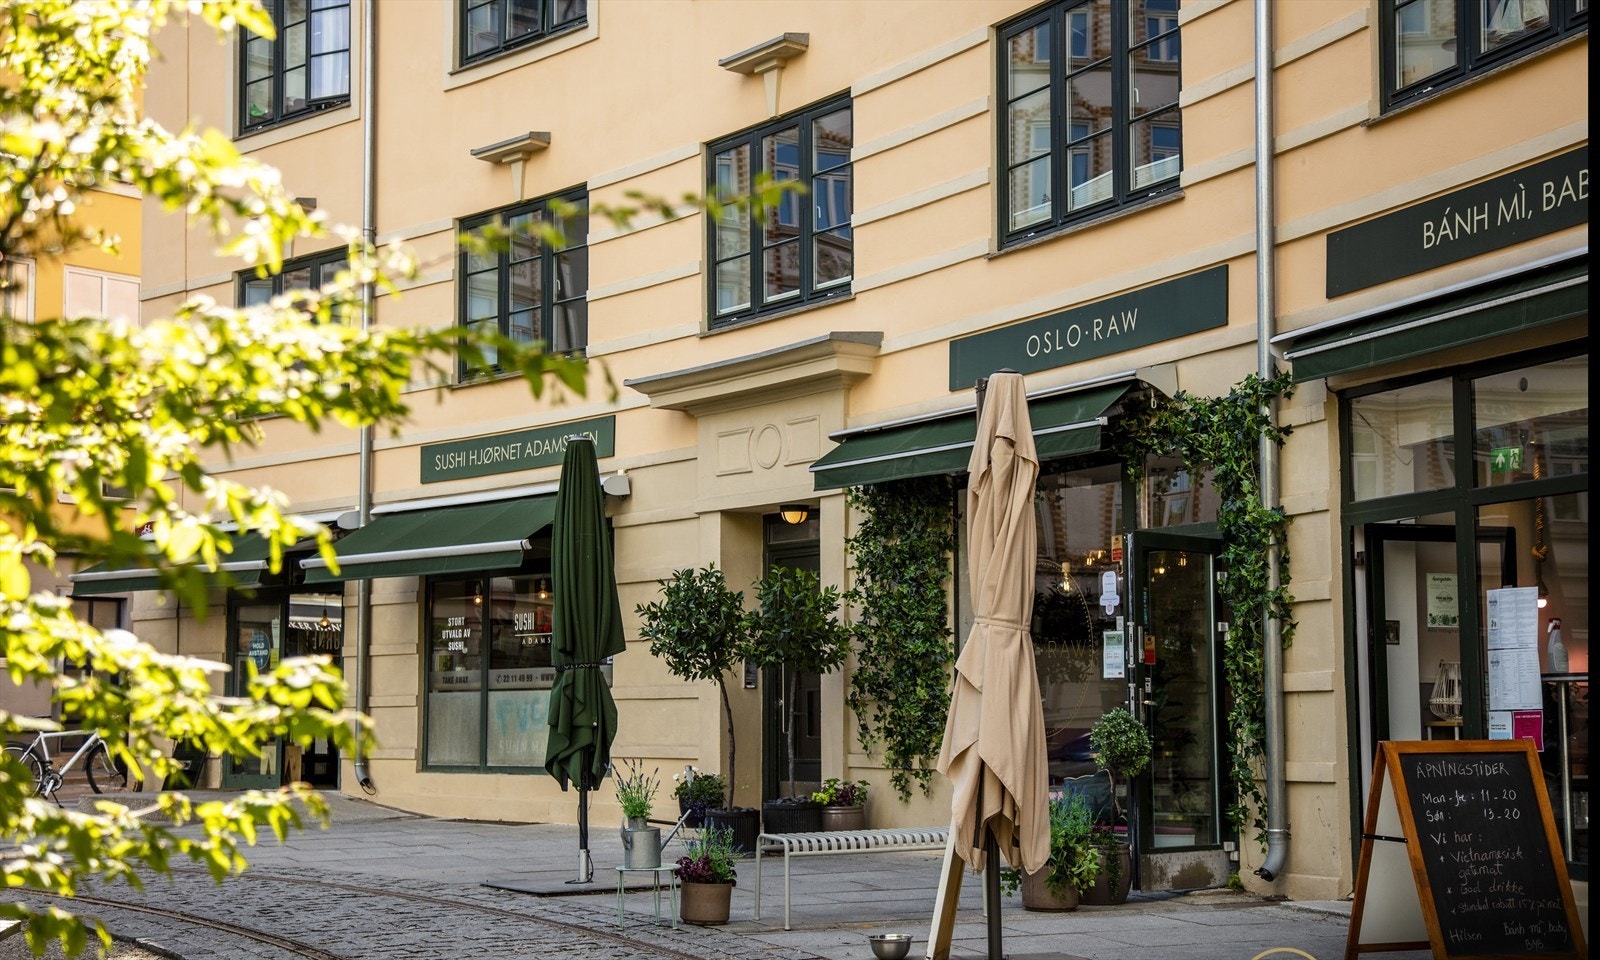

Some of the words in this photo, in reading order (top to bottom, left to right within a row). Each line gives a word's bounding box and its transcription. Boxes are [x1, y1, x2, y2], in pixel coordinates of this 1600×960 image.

[1423, 202, 1488, 250] BÁNH
[1497, 183, 1533, 227] MÌ,
[1542, 168, 1589, 212] BAB
[434, 451, 466, 471] SUSHI
[469, 442, 522, 466] HJØRNET
[524, 430, 598, 458] ADAMSN
[447, 616, 465, 627] STORT
[514, 612, 535, 631] SUSHI
[441, 628, 463, 639] UTVALG
[463, 628, 471, 638] AV
[252, 642, 265, 650] HOLD
[447, 641, 465, 651] SUSHI
[522, 637, 551, 645] ADAMS
[1047, 639, 1087, 658] RAW
[503, 675, 510, 683] 22
[511, 674, 517, 682] 11
[1430, 832, 1447, 845] Vi
